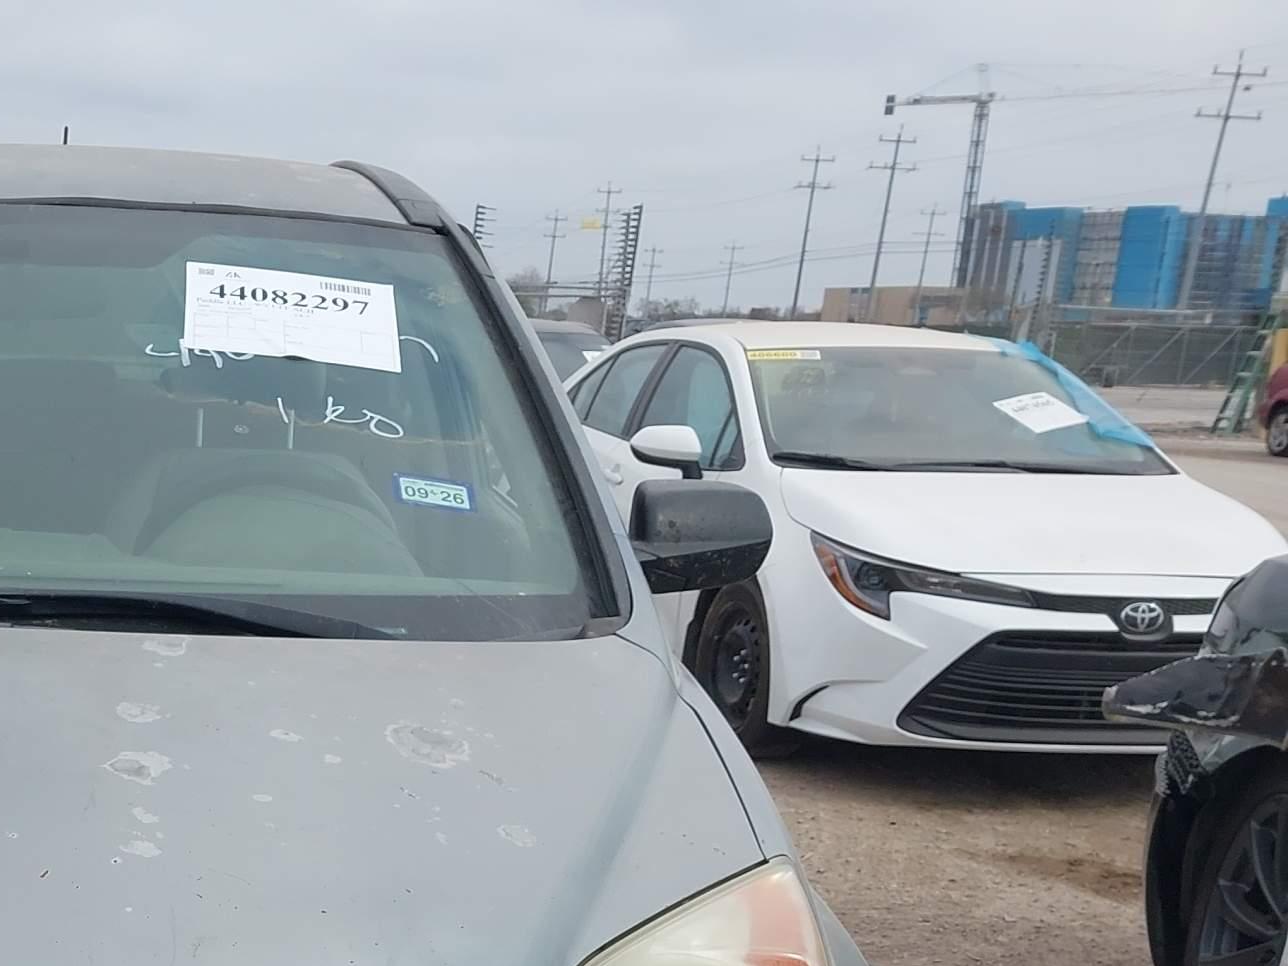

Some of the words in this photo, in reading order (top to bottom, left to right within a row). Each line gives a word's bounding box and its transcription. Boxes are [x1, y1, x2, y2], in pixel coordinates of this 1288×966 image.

[209, 283, 370, 316] 44082297
[404, 485, 429, 499] 09
[439, 490, 465, 505] 26
